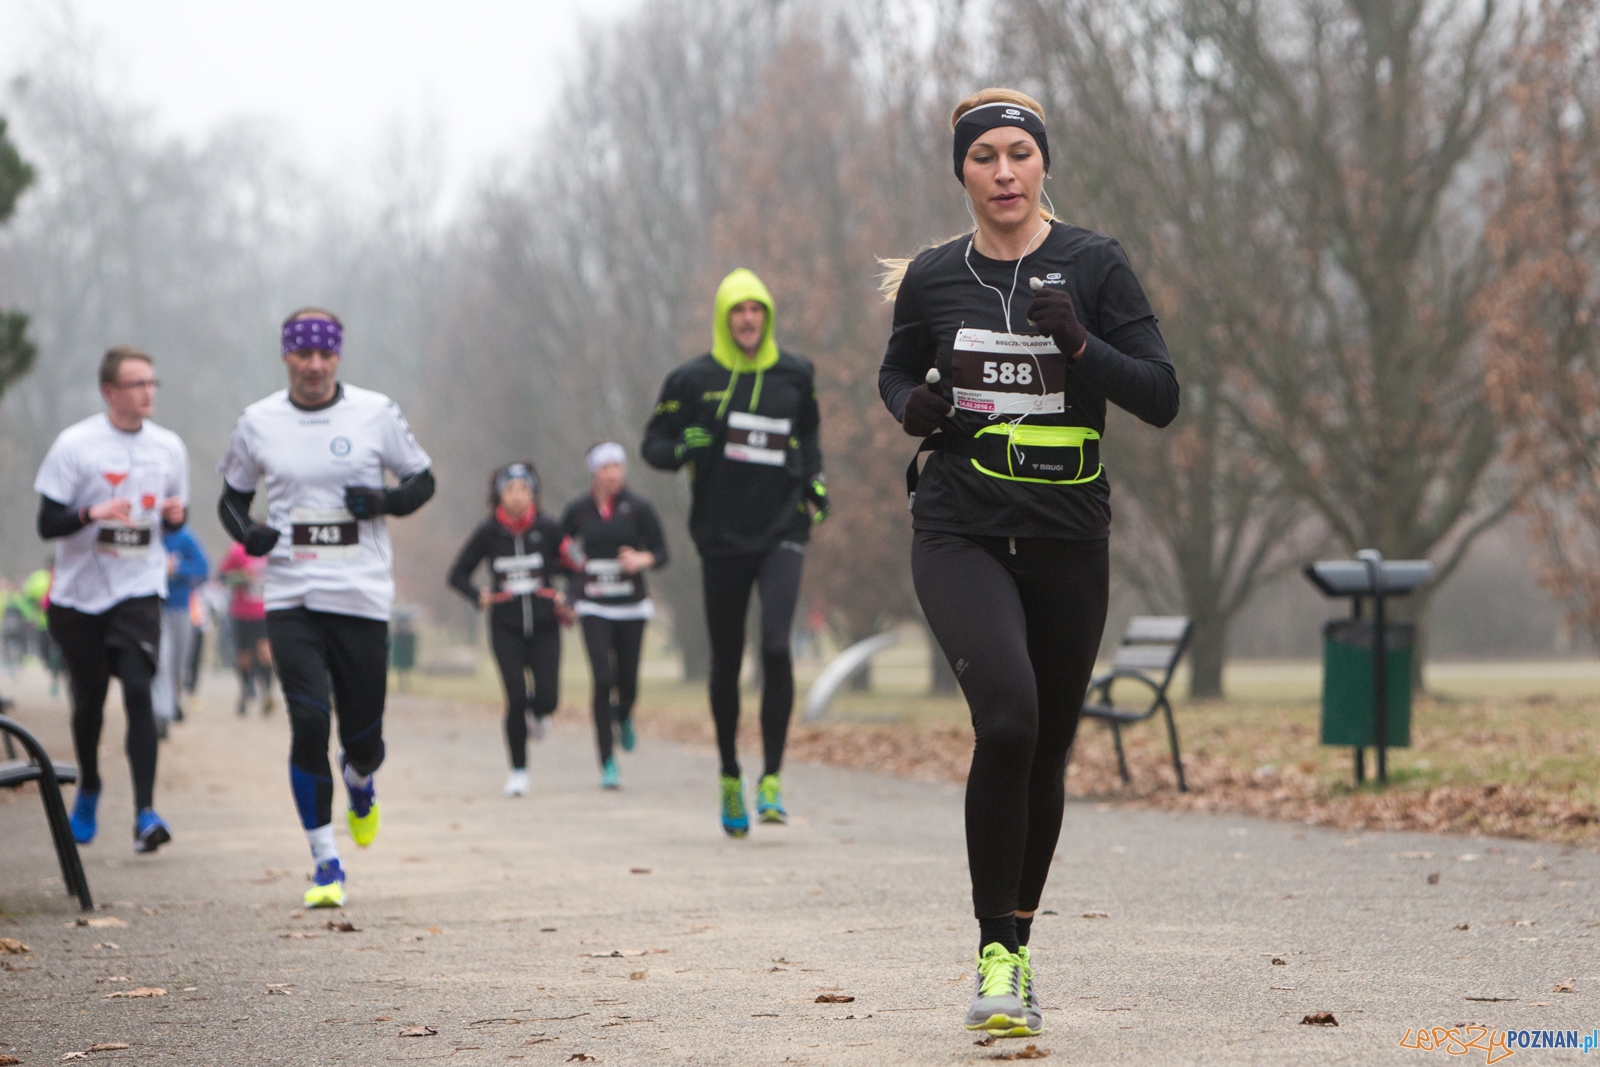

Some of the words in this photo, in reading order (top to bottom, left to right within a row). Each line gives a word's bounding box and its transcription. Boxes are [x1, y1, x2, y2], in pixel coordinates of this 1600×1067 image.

[982, 361, 1033, 385] 588
[1040, 463, 1064, 471] BRUGI
[308, 526, 341, 544] 743
